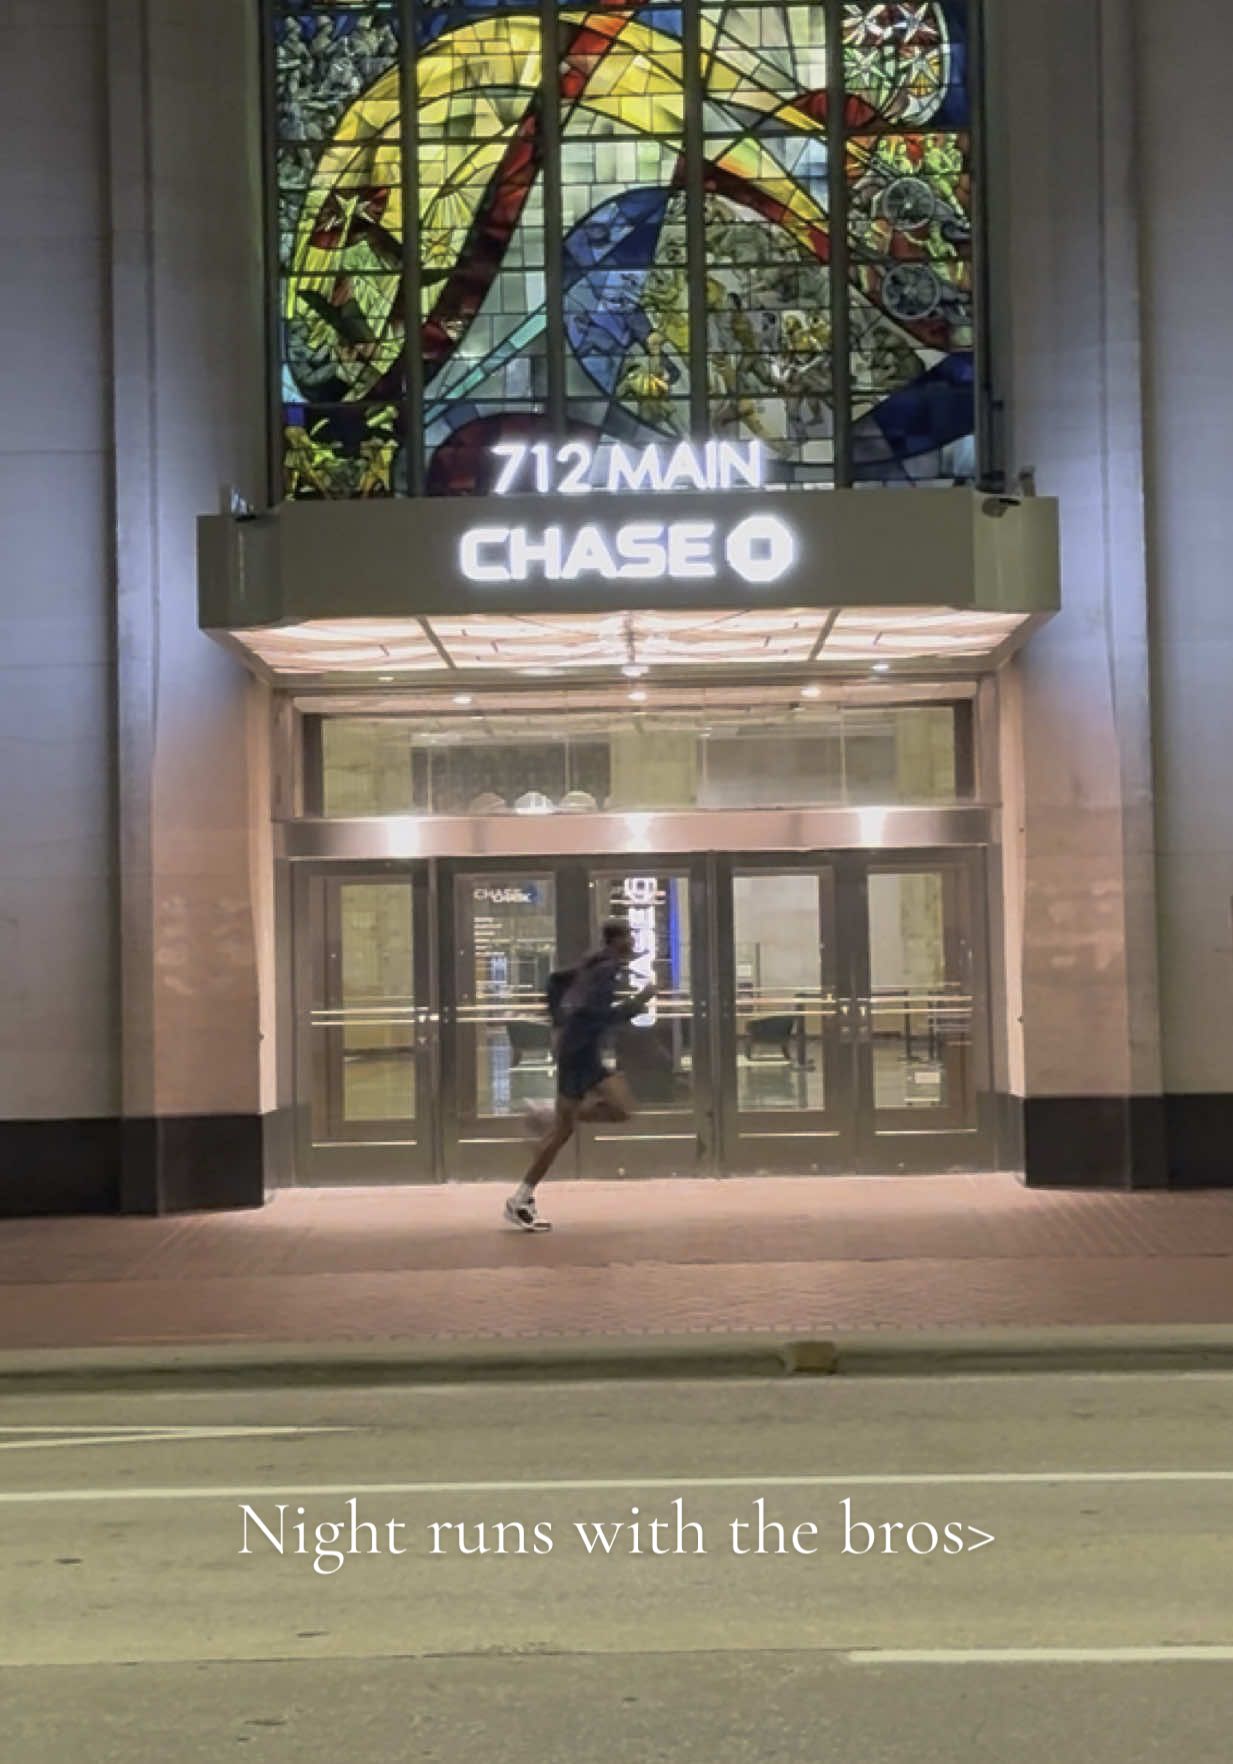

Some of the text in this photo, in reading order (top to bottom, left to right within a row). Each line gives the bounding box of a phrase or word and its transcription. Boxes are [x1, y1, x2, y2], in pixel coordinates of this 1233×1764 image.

[492, 440, 761, 493] 712 MAIN
[460, 523, 716, 581] CHASE
